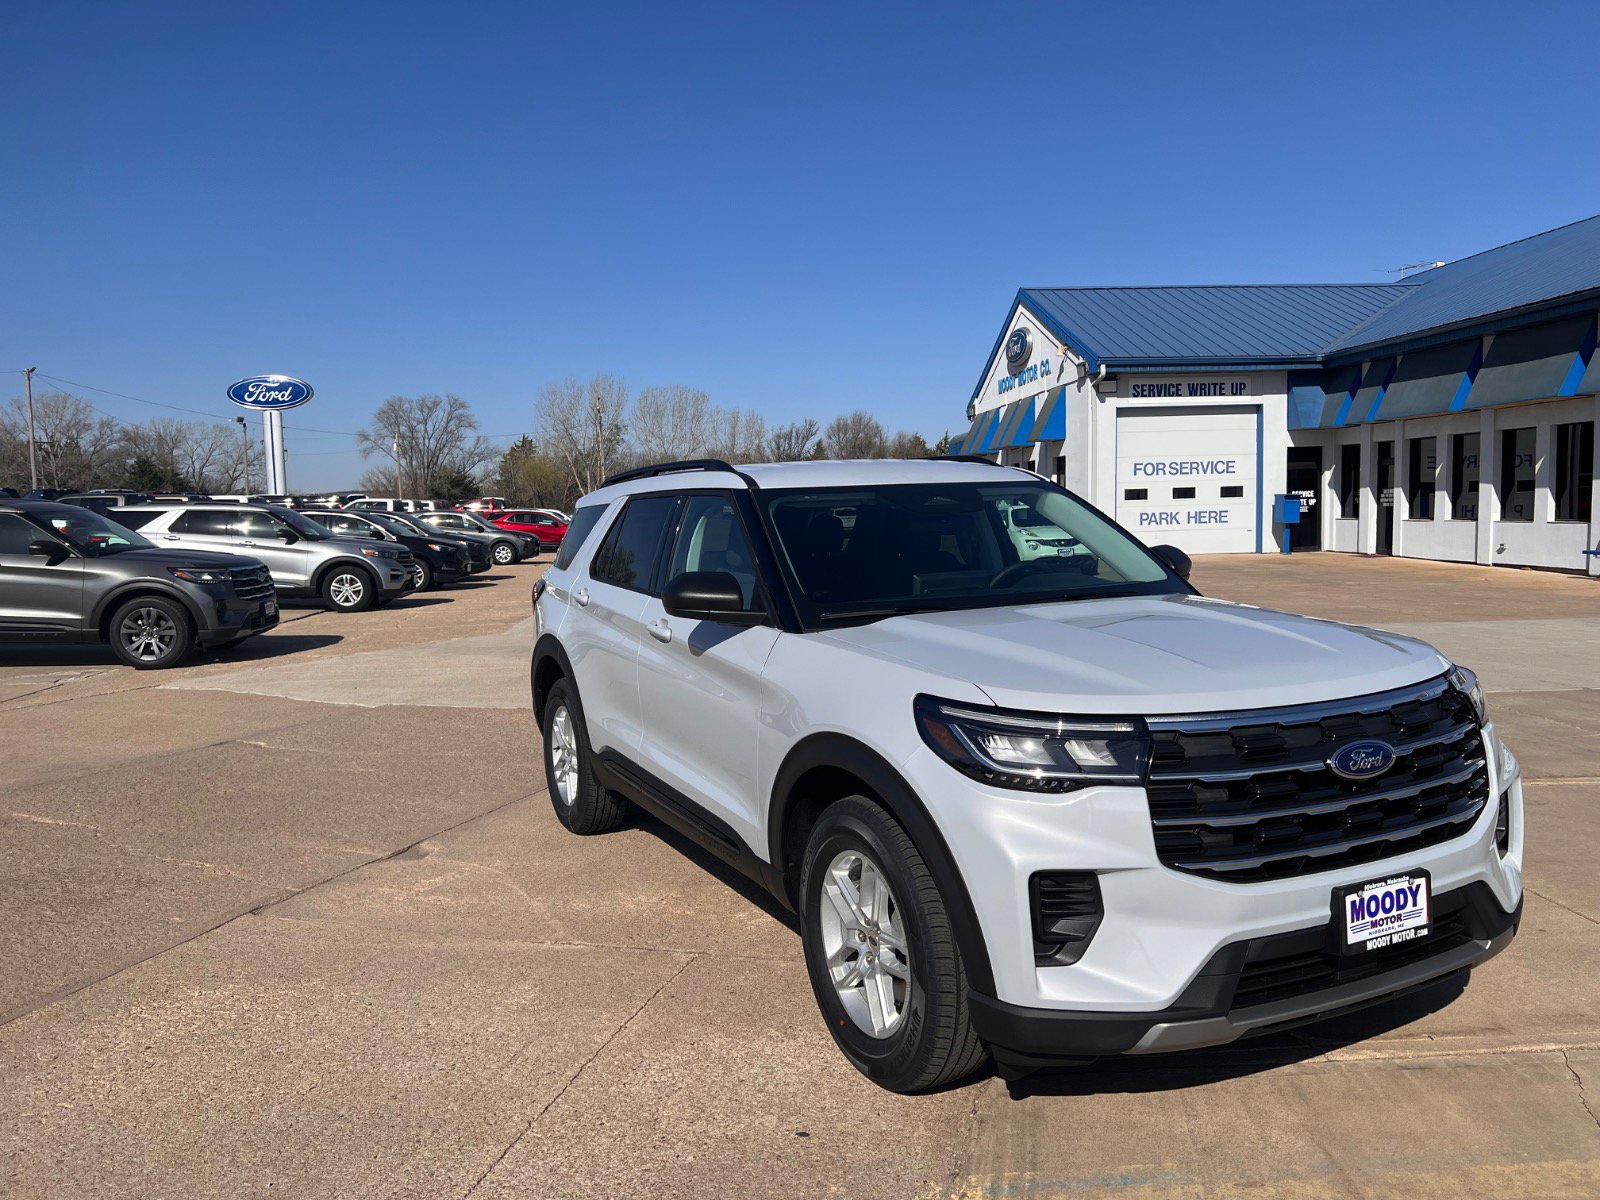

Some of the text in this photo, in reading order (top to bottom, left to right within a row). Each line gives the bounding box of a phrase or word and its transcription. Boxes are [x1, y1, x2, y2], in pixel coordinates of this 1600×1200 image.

[1018, 364, 1038, 386] MOTOR
[1040, 358, 1051, 378] CO.
[244, 382, 292, 402] Ford
[1132, 381, 1247, 398] SERVICE WRITE UP
[1133, 460, 1236, 476] FOR SERVICE
[1308, 498, 1316, 506] UP
[1139, 510, 1228, 526] PARK HERE
[1349, 748, 1384, 771] Ford
[1350, 883, 1421, 924] MOODY
[1370, 913, 1403, 929] MOTOR
[1366, 935, 1391, 951] MOODY
